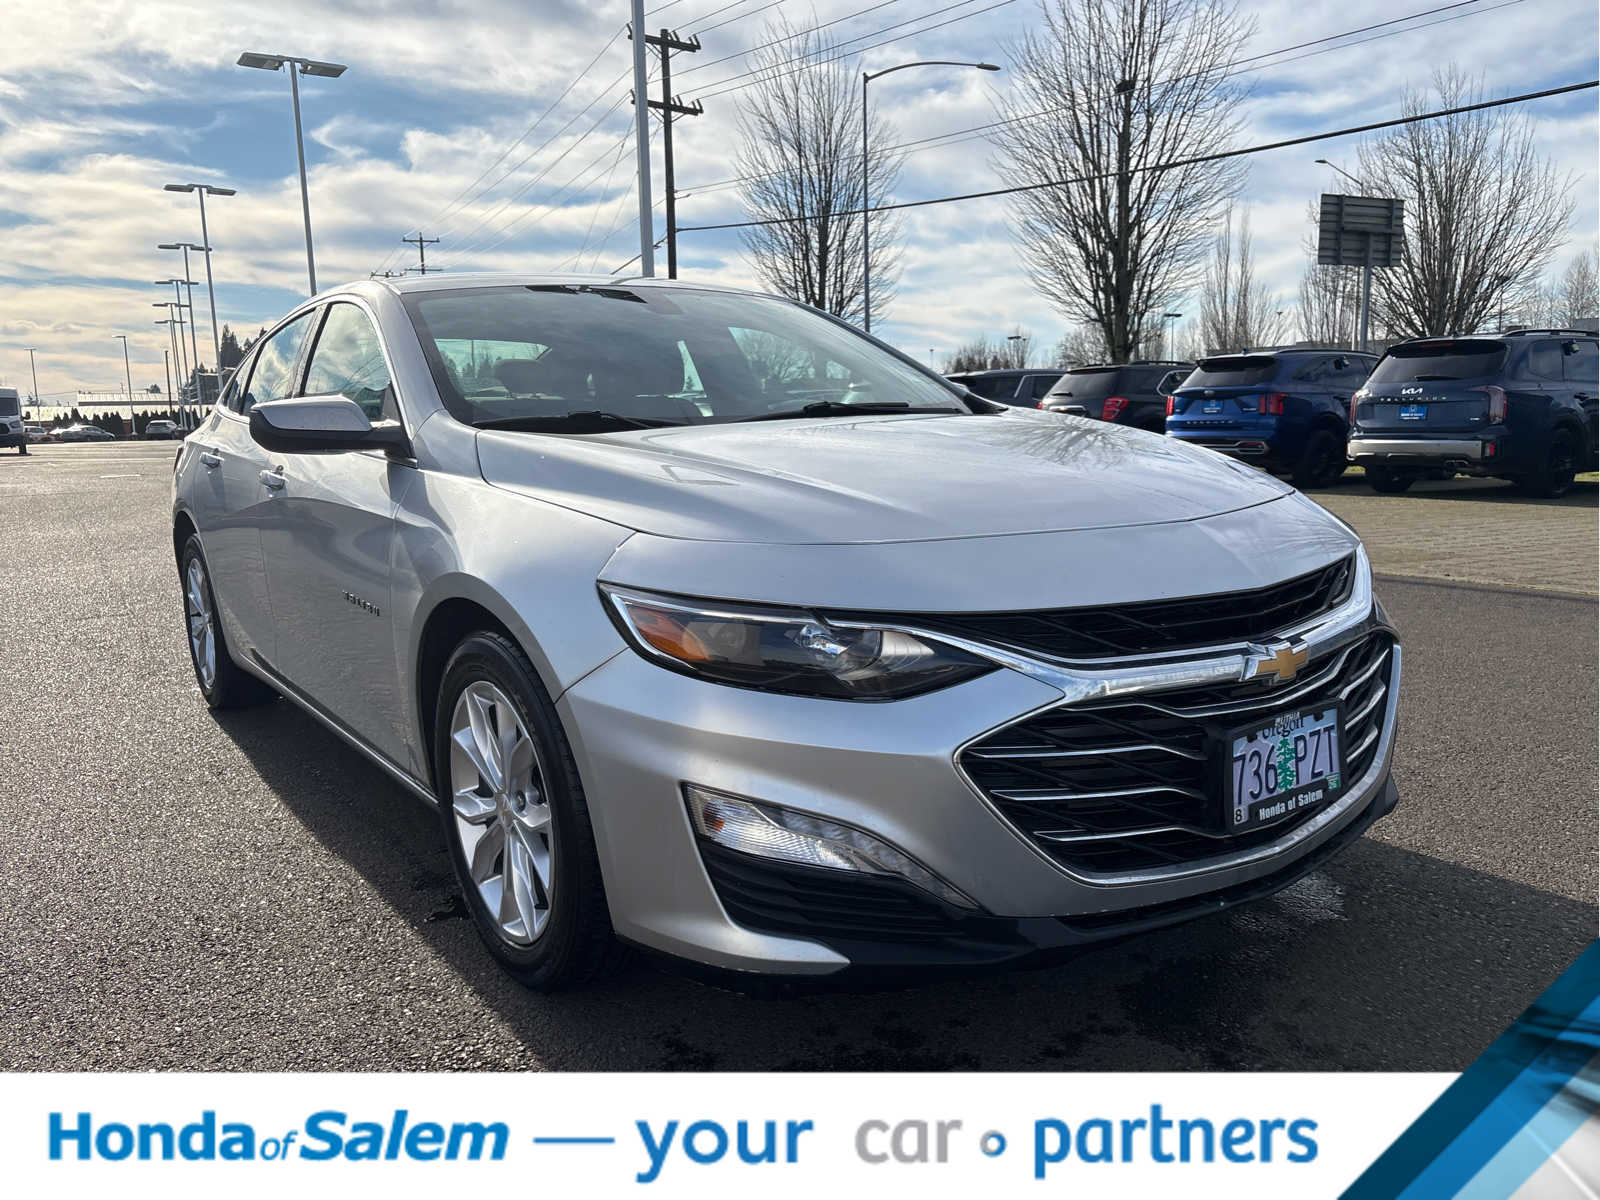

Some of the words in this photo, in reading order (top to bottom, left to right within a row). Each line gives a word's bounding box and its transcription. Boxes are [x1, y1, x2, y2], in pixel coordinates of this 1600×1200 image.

[1232, 744, 1278, 806] 736
[1294, 725, 1336, 785] PZT
[1234, 808, 1244, 823] 8
[1259, 801, 1286, 821] Honda
[1288, 795, 1296, 810] of
[1298, 789, 1323, 807] Salem
